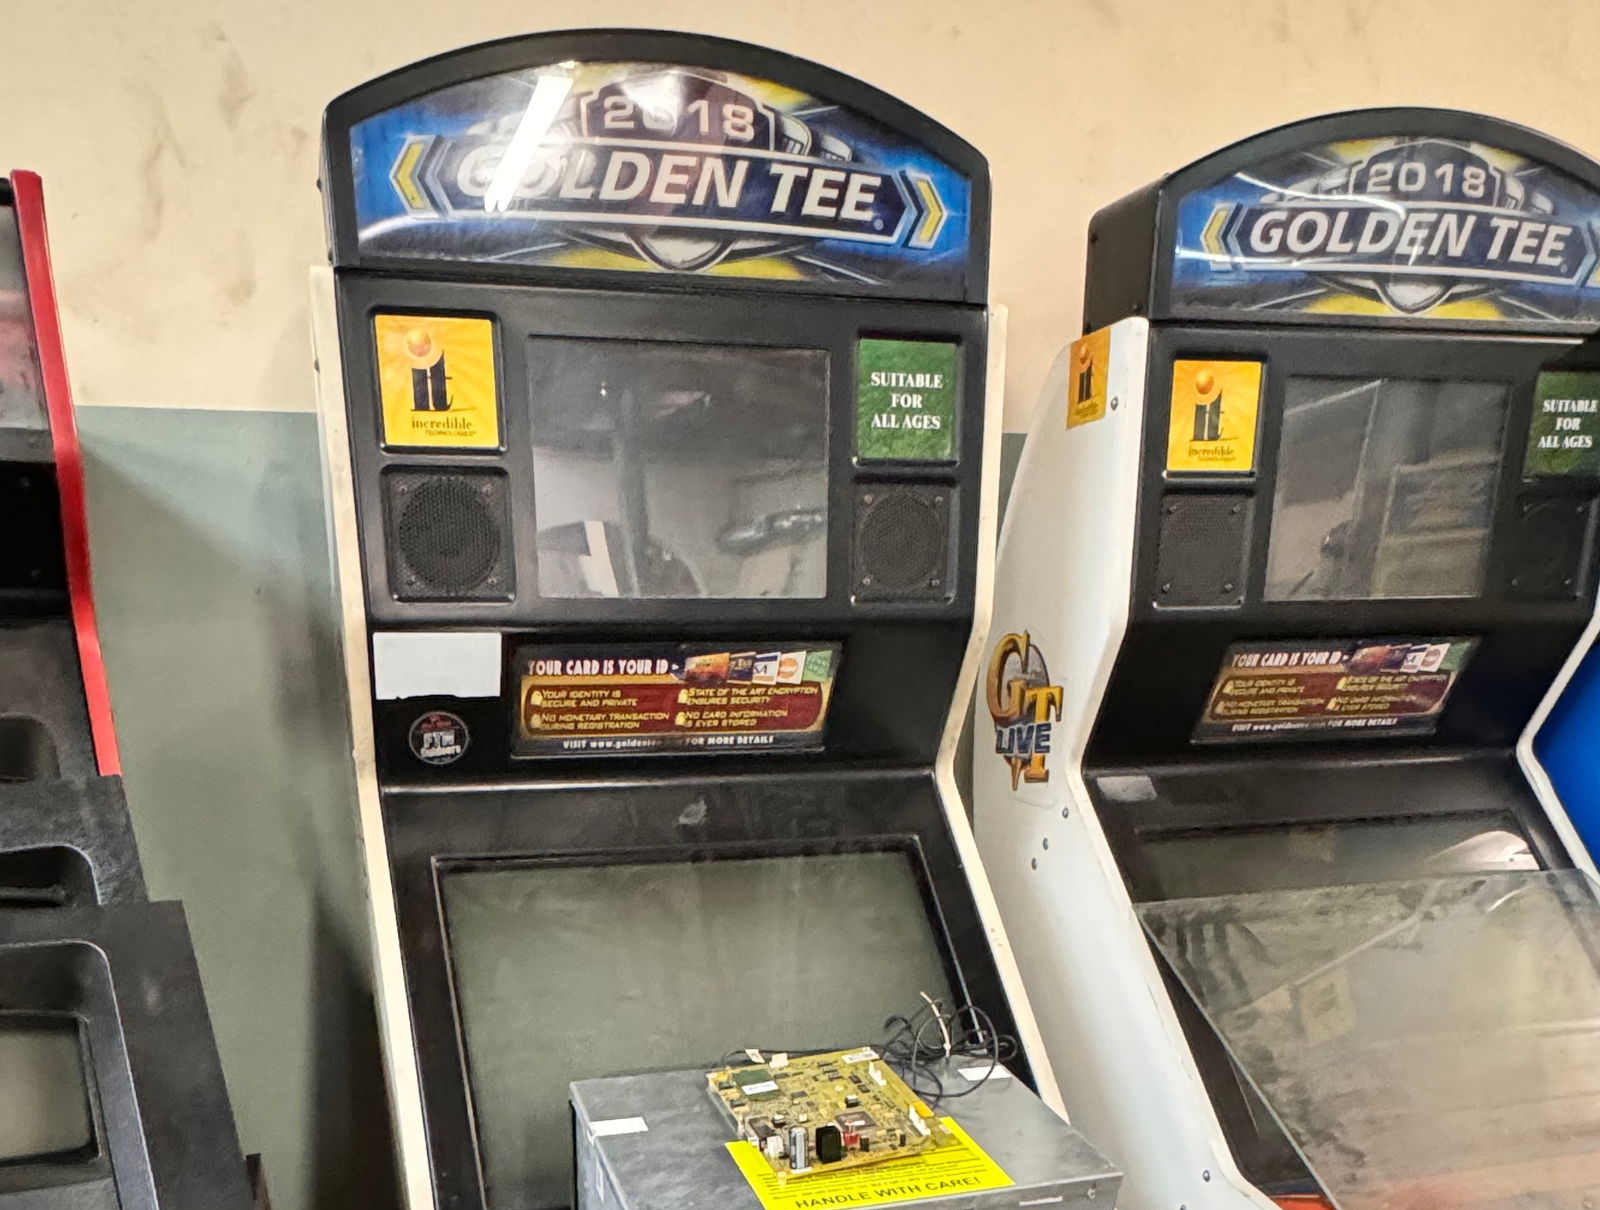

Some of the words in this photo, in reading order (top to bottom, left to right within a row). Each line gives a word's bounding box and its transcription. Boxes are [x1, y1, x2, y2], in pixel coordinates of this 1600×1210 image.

[1367, 161, 1487, 198] 2018
[769, 161, 883, 221] TEE
[1250, 209, 1469, 259] GOLDEN
[1486, 218, 1573, 267] TEE
[870, 371, 943, 389] SUITABLE
[891, 393, 923, 409] FOR
[1542, 399, 1598, 413] SUITABLE
[411, 416, 472, 430] incredible
[871, 413, 900, 429] ALL
[902, 414, 941, 430] AGES
[1555, 417, 1581, 431] FOR
[1537, 435, 1560, 449] ALL
[1561, 435, 1593, 449] AGES
[1231, 653, 1260, 667] YOUR
[1260, 653, 1289, 667] CARD
[1288, 652, 1301, 666] IS
[1300, 651, 1330, 666] YOUR
[529, 659, 562, 676] YOUR
[566, 659, 600, 676] CARD
[603, 659, 615, 676] IS
[618, 659, 653, 675] YOUR
[656, 658, 669, 675] ID
[570, 690, 609, 698] IDENTITY
[688, 687, 716, 697] STATE
[718, 687, 730, 696] OF
[732, 687, 747, 696] THE
[749, 687, 766, 695] ART
[768, 686, 819, 695] ENCRYPTION
[580, 699, 600, 707] AND
[602, 698, 639, 707] PRIVATE
[730, 696, 771, 705] SECURITY
[609, 712, 670, 721] TRANSACTION
[686, 711, 699, 720] NO
[702, 711, 727, 720] CARD
[729, 709, 788, 719] INFORMATION
[695, 719, 718, 727] EVER
[563, 739, 588, 749] VISIT
[706, 735, 735, 745] MORE
[737, 735, 774, 745] DETAILS
[995, 722, 1053, 755] LIVE
[796, 1192, 871, 1210] HANDLE
[875, 1185, 922, 1200] WITH
[926, 1176, 983, 1192] CARE!
